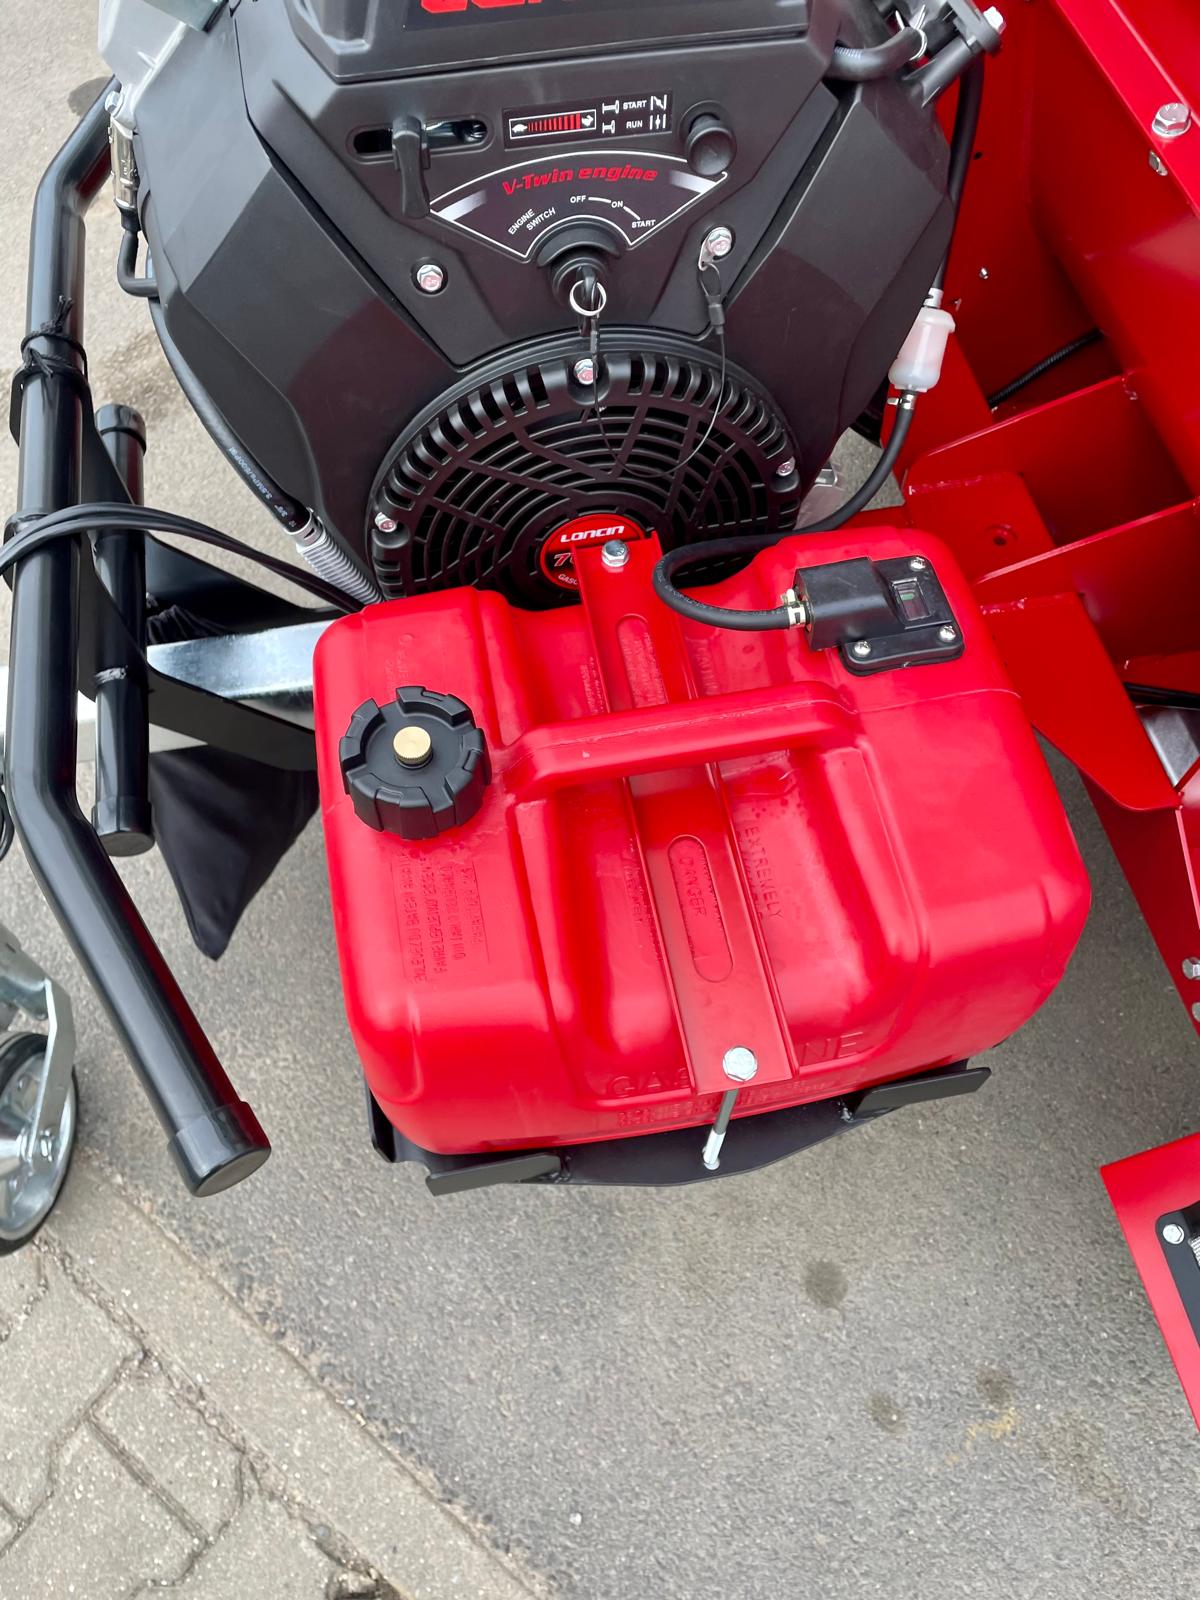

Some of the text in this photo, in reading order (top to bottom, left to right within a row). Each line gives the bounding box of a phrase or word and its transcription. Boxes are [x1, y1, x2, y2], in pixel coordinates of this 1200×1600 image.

[623, 100, 647, 110] START
[626, 120, 643, 129] RUN
[502, 164, 658, 196] V-Twin engine
[508, 208, 535, 235] ENGINE
[526, 207, 556, 231] SWITCH
[570, 194, 656, 229] OFF ON START
